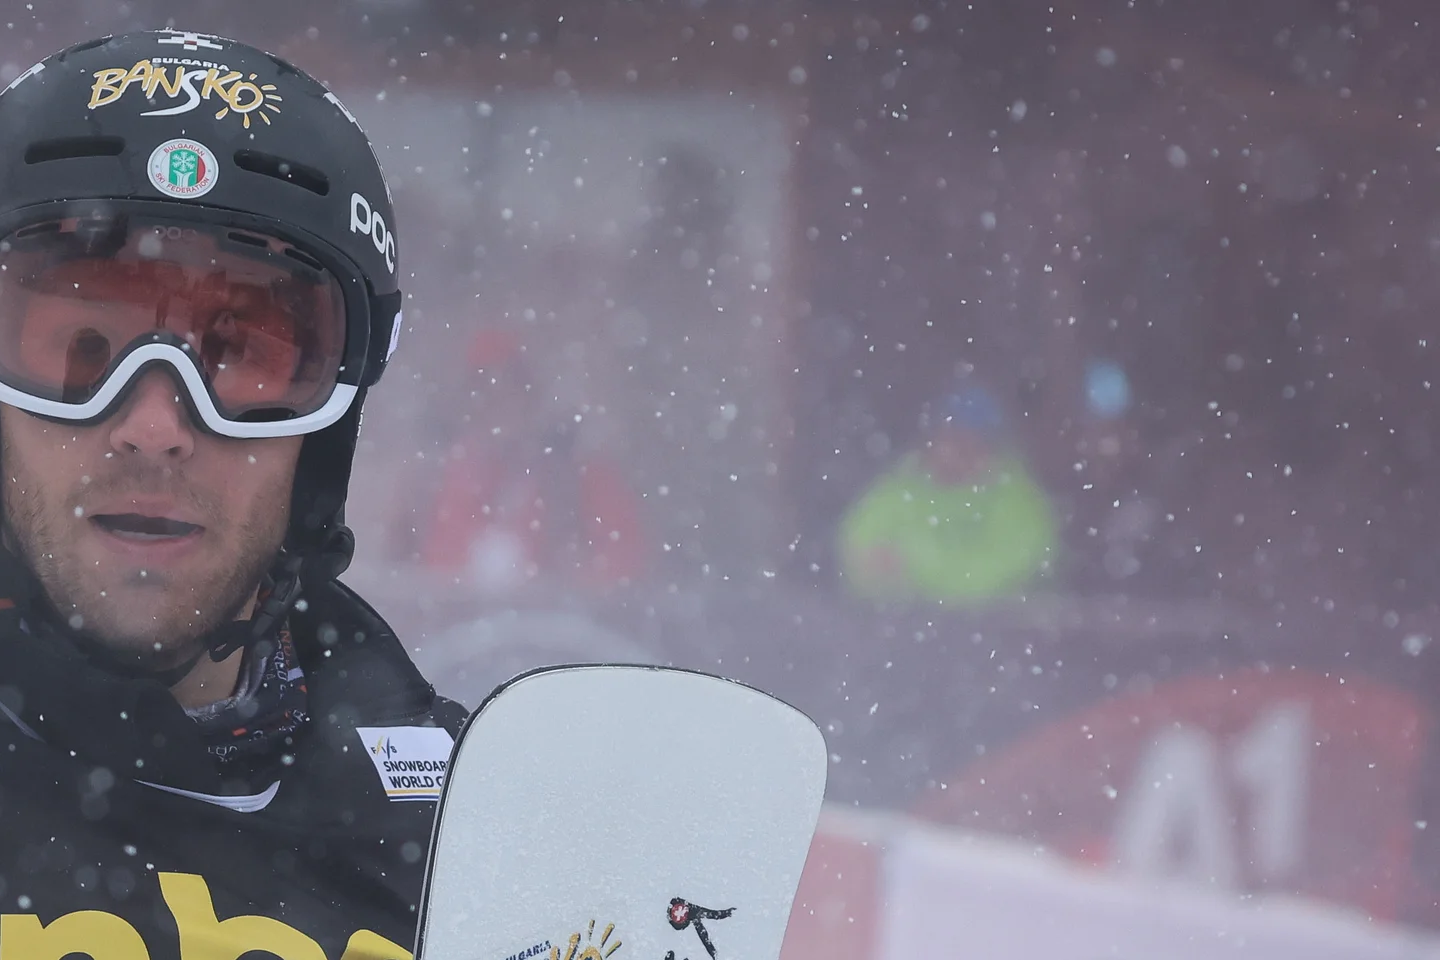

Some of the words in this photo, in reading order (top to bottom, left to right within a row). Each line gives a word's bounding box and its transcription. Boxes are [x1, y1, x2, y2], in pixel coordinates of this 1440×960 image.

[152, 57, 230, 72] BULGARIA
[87, 59, 270, 118] BANSKO
[163, 143, 205, 157] BULGARIAN
[155, 172, 166, 184] SKI
[166, 177, 210, 194] FEDERATION
[388, 776, 434, 788] WORLD
